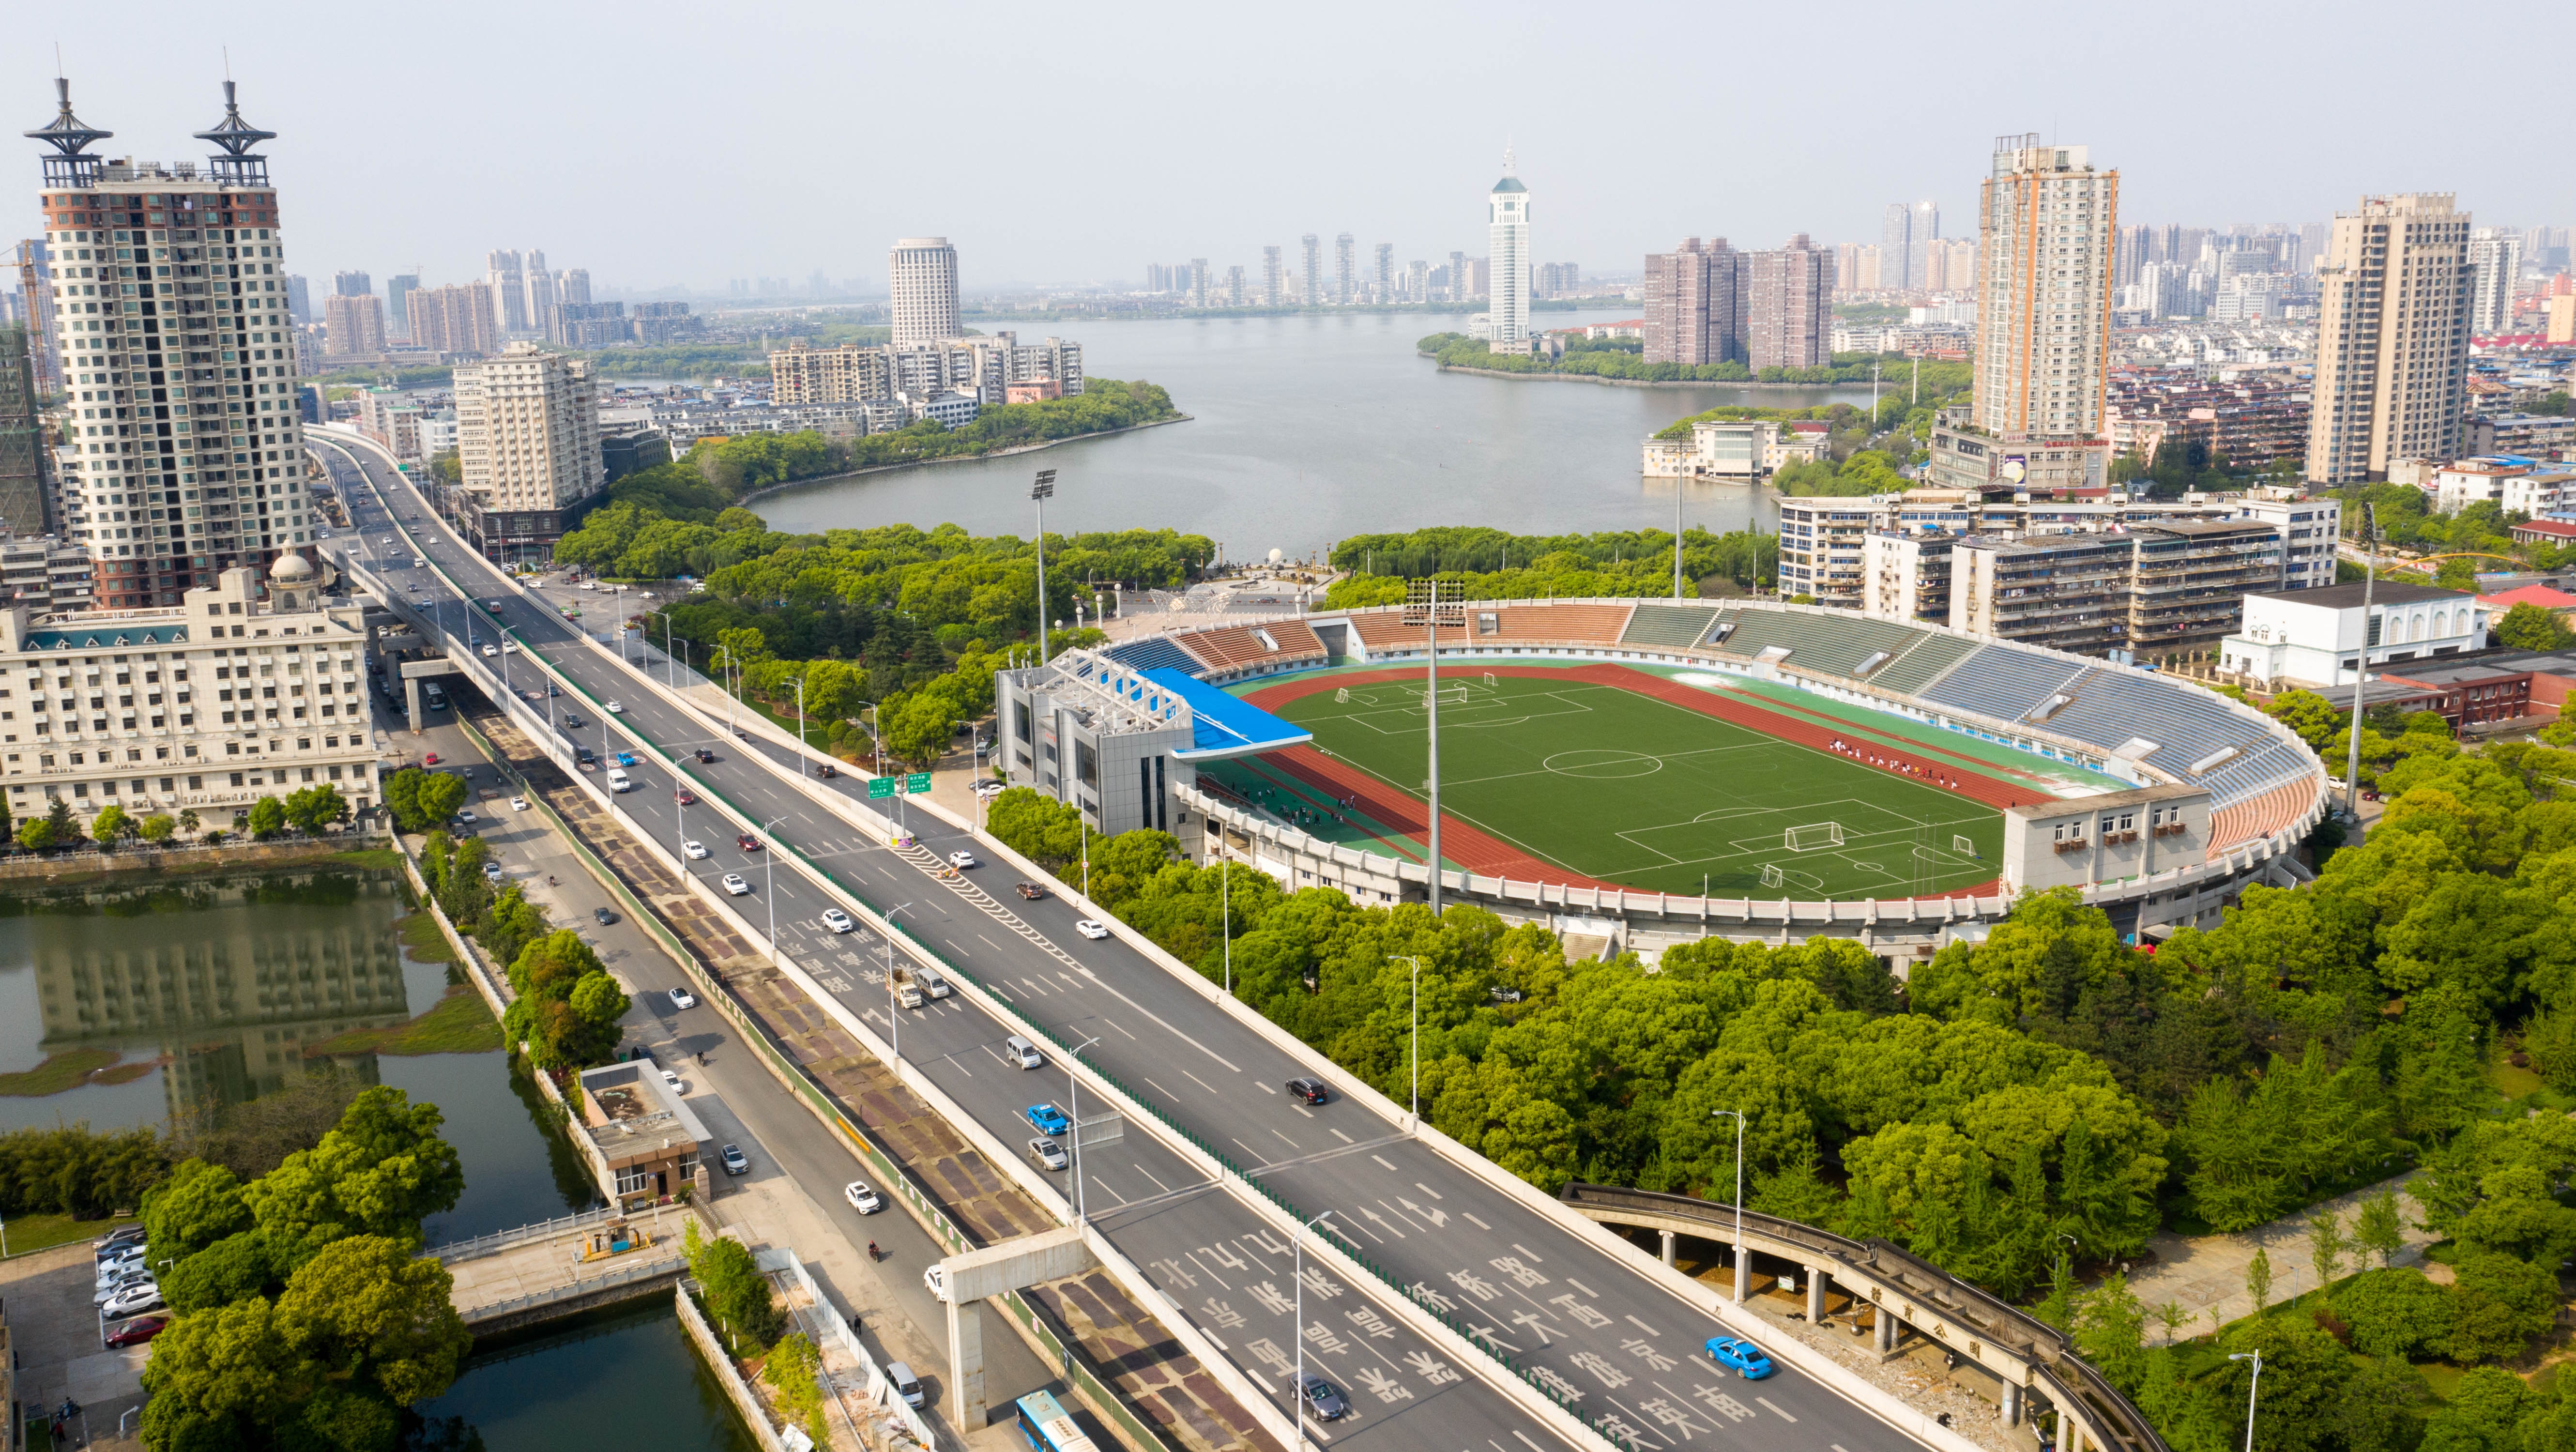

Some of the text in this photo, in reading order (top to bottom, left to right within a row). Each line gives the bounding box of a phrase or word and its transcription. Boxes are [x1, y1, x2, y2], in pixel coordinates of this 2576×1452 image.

[1446, 1269, 1711, 1440] 英雄大桥
[1489, 1256, 1756, 1423] 南京西路
